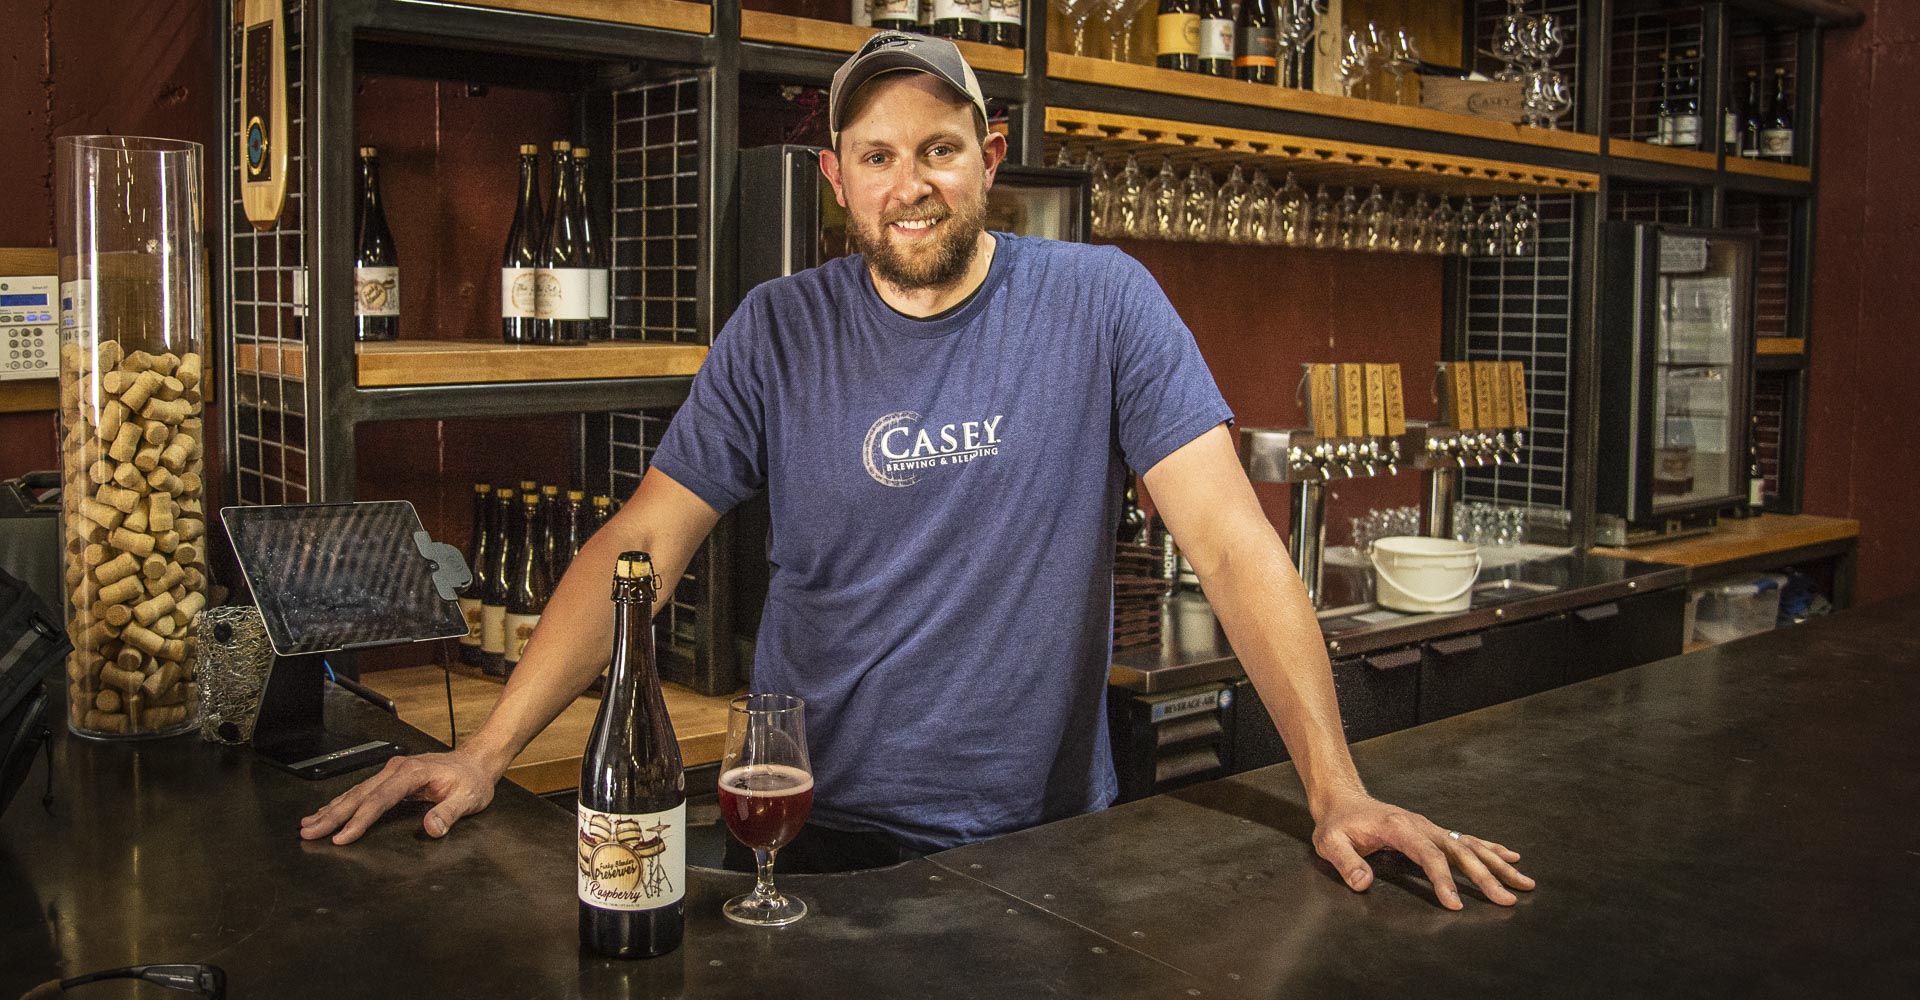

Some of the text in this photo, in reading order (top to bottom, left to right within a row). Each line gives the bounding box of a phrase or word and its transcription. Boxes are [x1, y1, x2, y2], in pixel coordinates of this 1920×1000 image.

[1349, 369, 1360, 421] CASEY
[1371, 369, 1381, 419] CASEY
[1389, 369, 1401, 420] CASEY
[886, 459, 936, 472] BREWING
[940, 457, 948, 465] &
[595, 864, 638, 880] Preserves
[599, 858, 635, 870] Funky Blender
[589, 880, 642, 904] Raspberry
